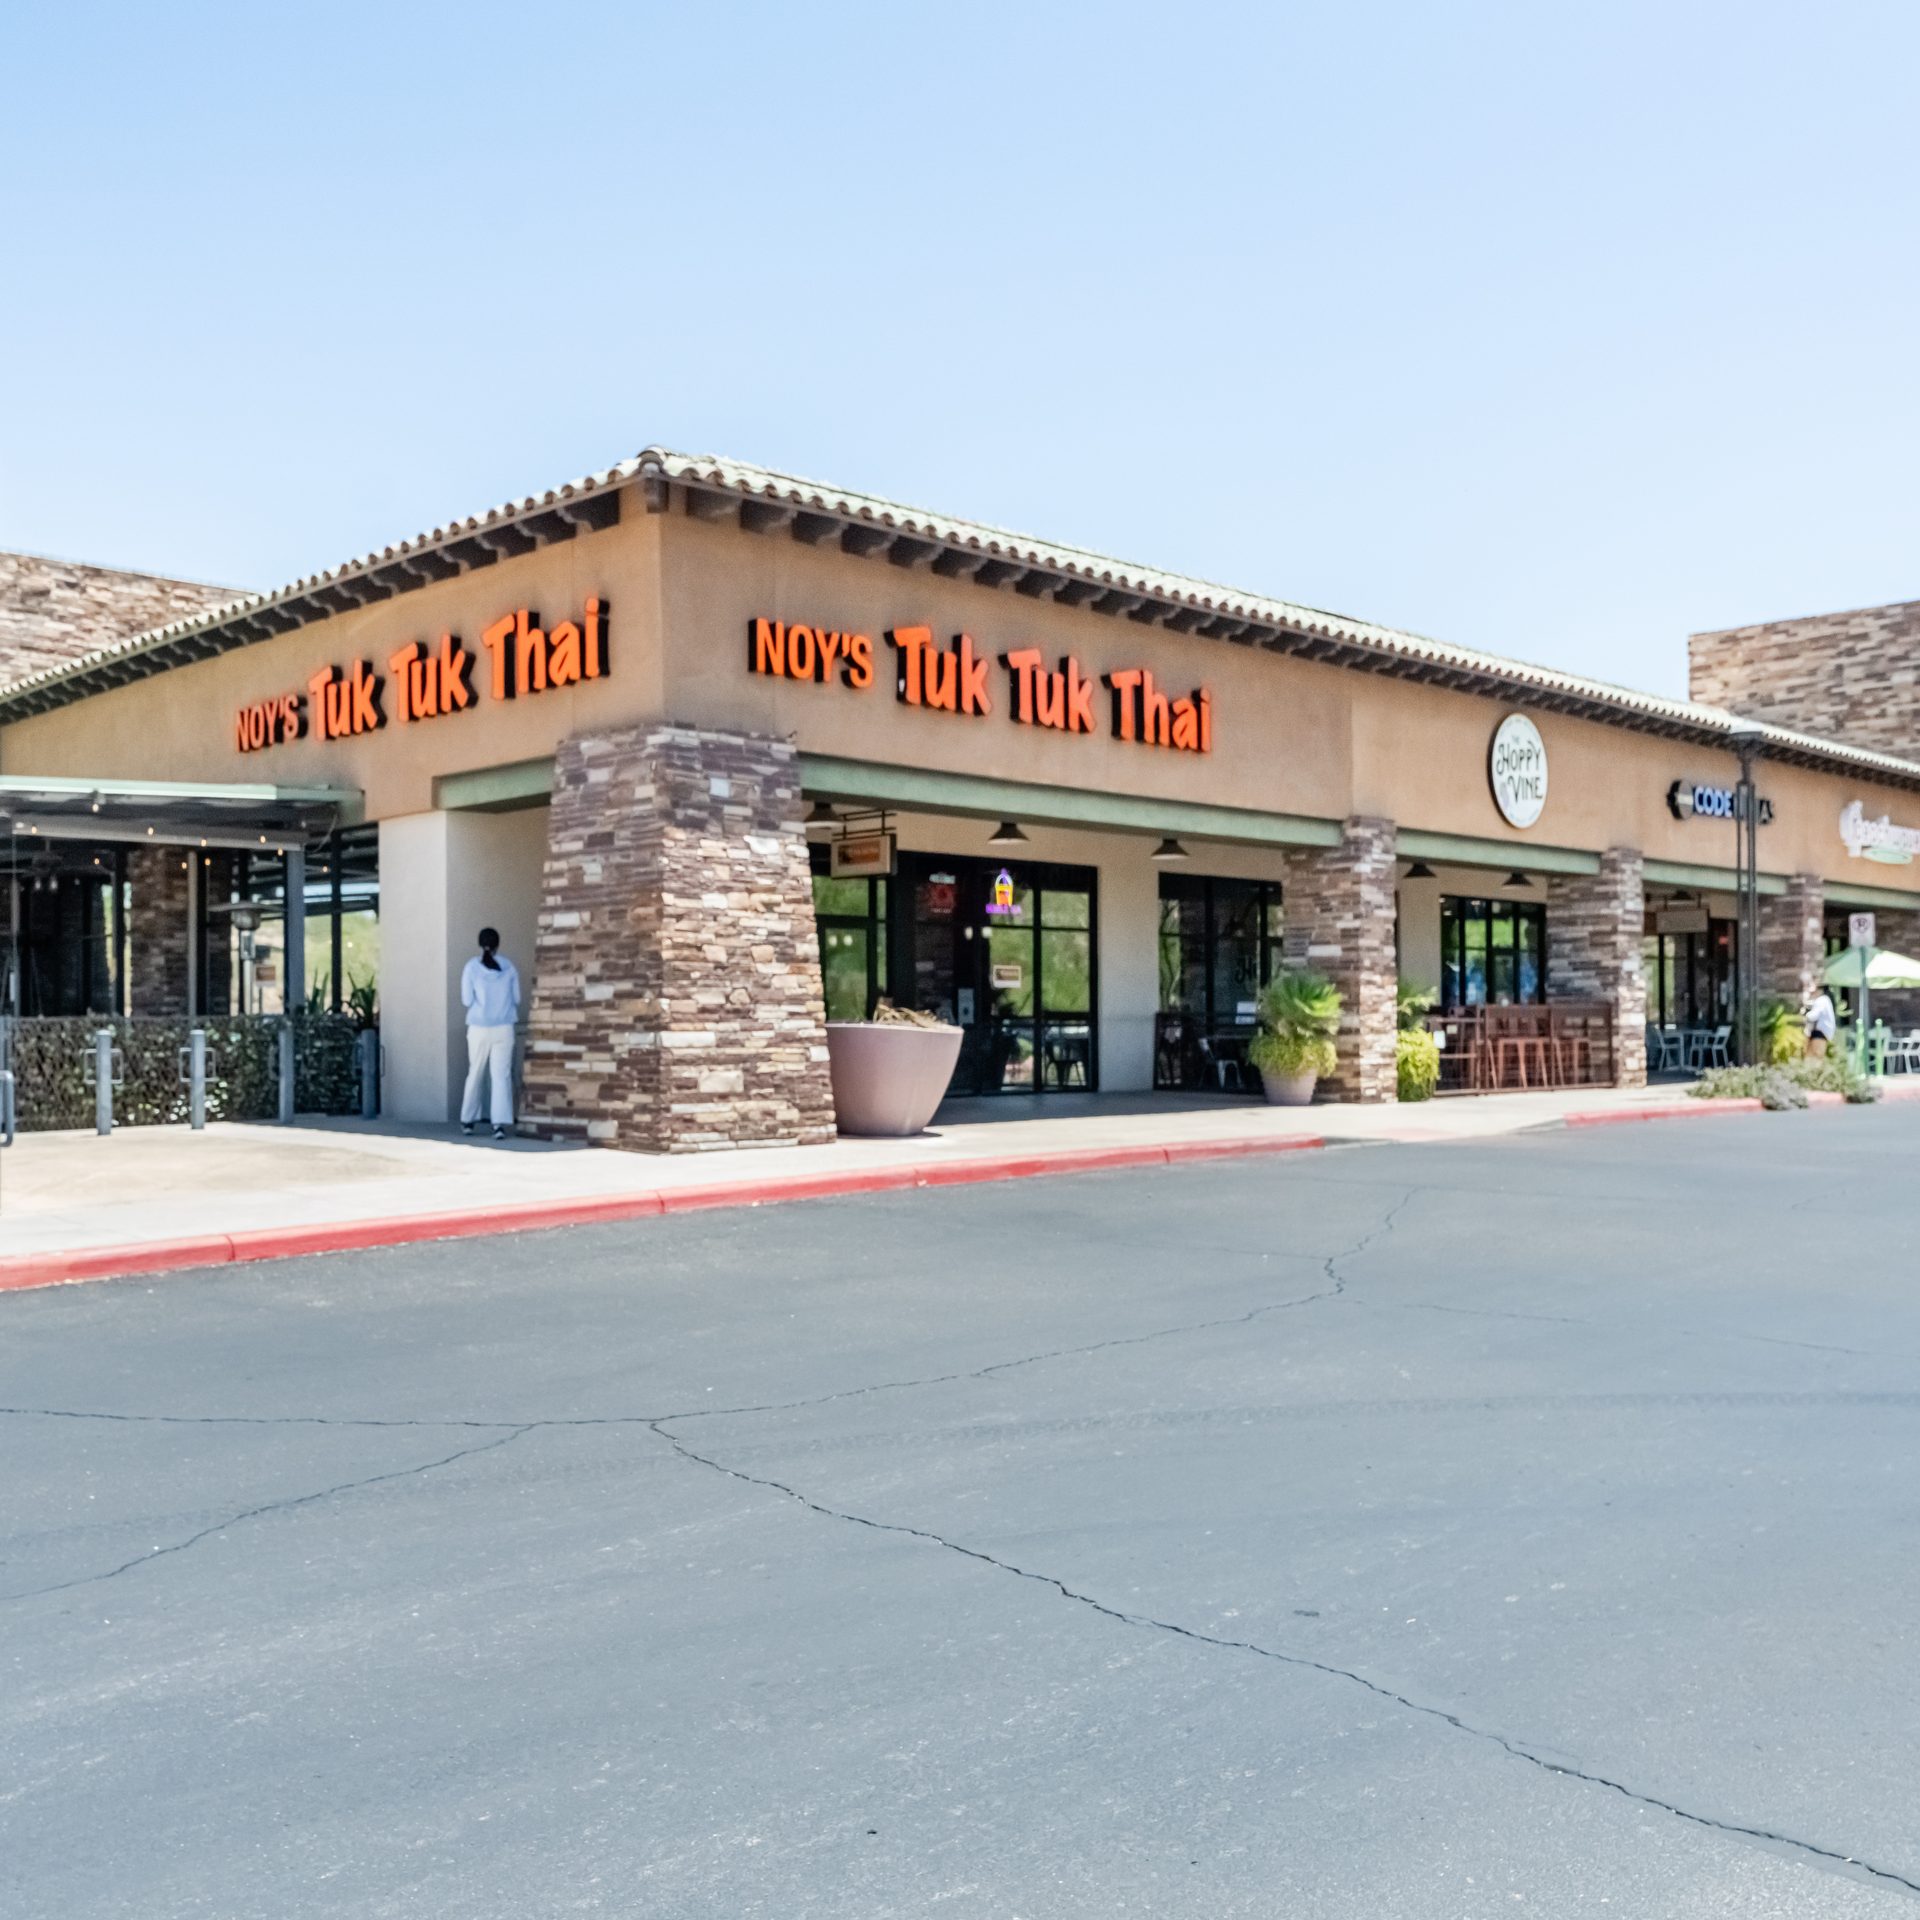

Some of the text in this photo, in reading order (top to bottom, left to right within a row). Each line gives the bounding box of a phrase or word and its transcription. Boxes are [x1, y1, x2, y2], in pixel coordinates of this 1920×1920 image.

[236, 596, 607, 752] NOY'S Tuk Tuk Thai
[750, 617, 1211, 752] NOY'S Tuk Tuk Thai
[1496, 740, 1542, 775] HOPPY
[1507, 775, 1544, 803] VINE
[1693, 785, 1733, 818] CODE
